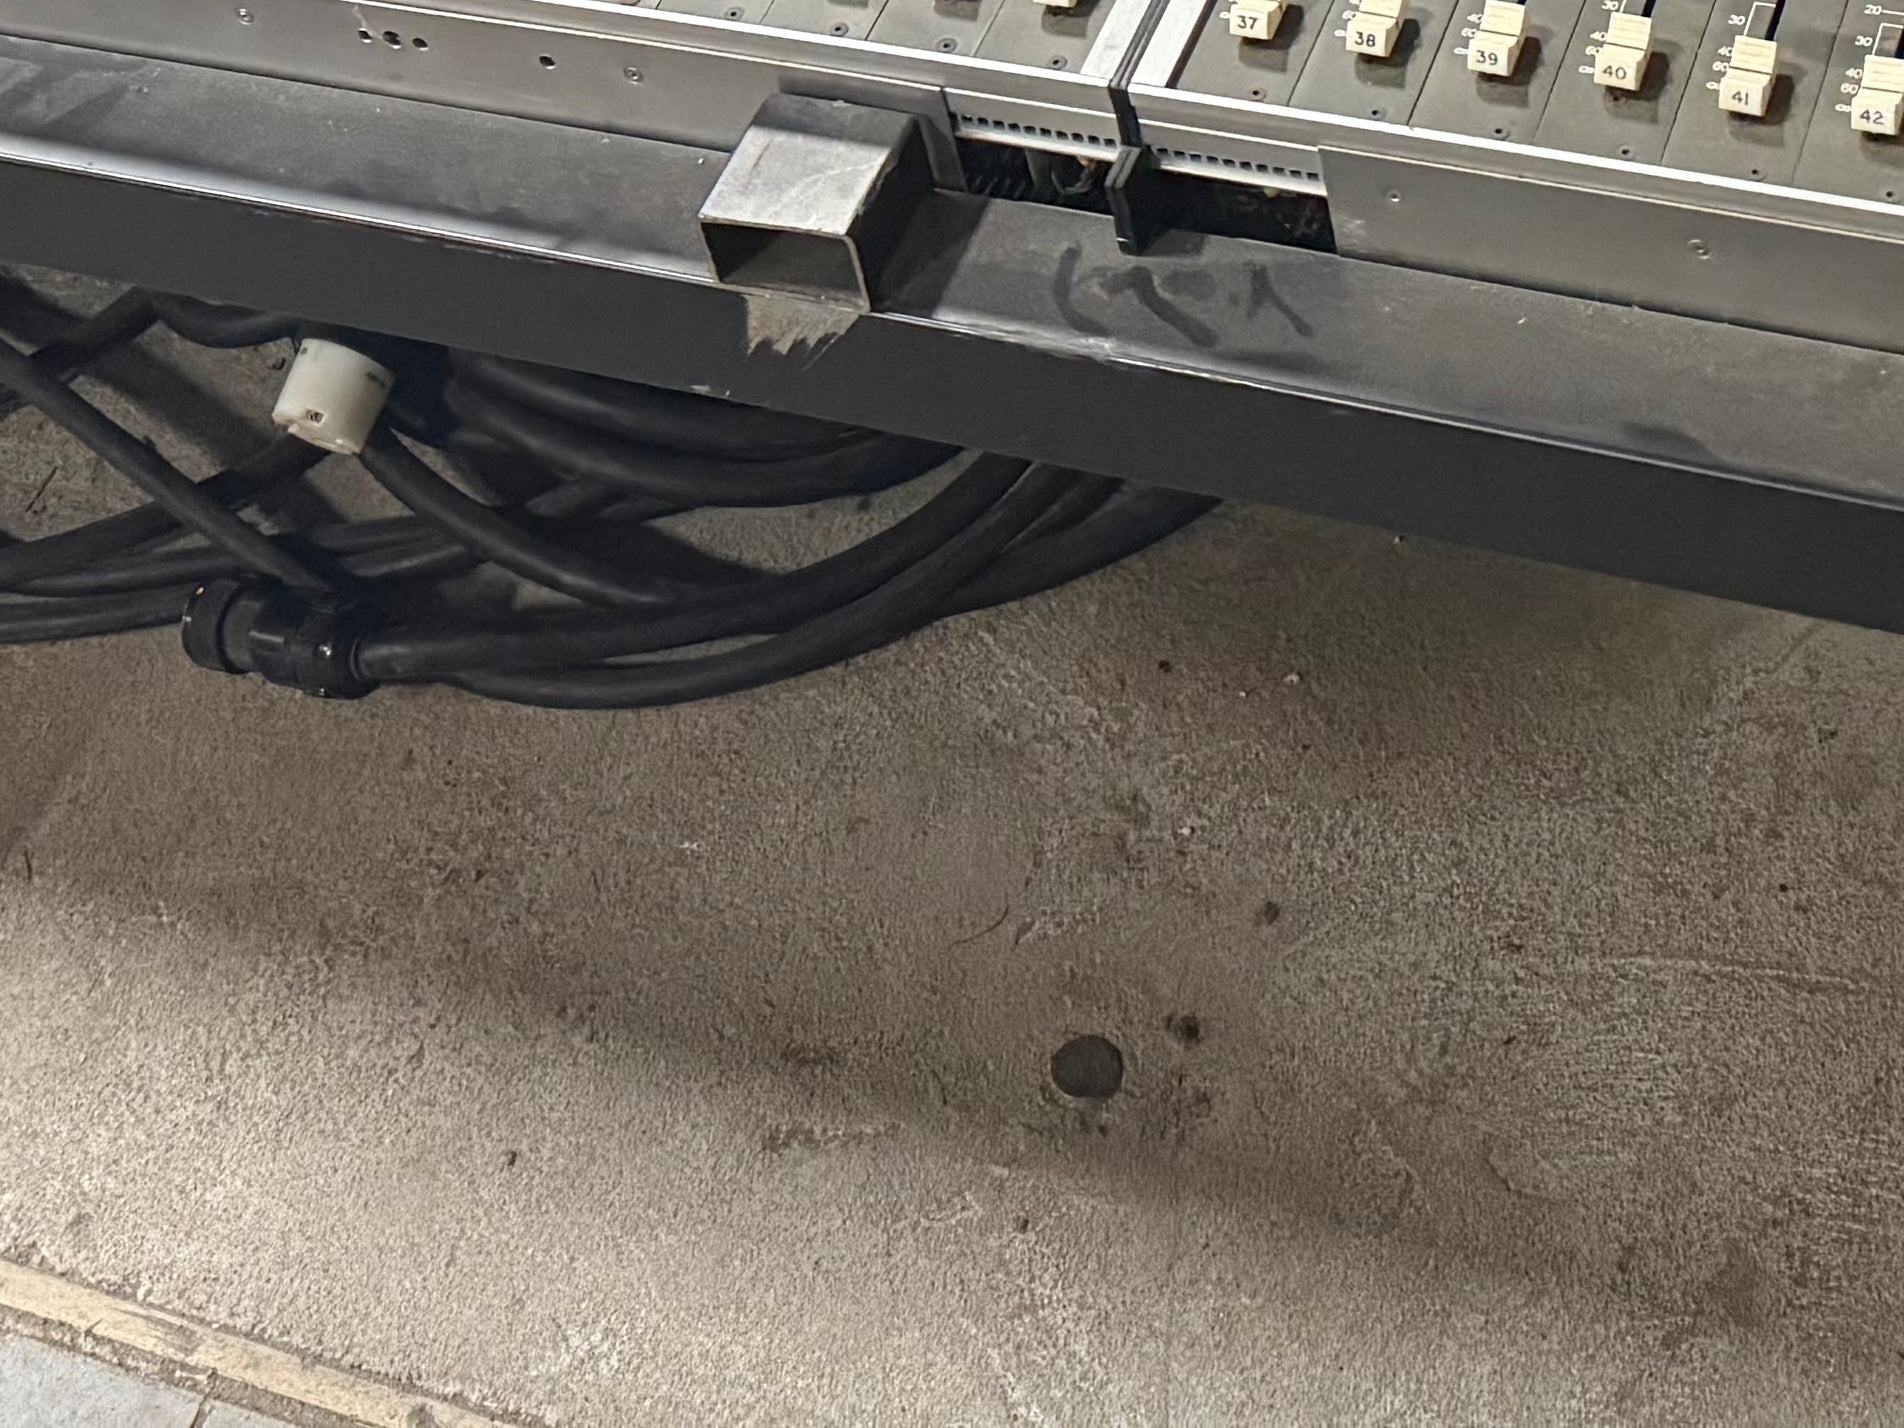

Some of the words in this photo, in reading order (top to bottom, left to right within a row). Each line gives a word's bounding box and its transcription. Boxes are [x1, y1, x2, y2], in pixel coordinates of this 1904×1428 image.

[1864, 5, 1882, 15] 20
[1237, 15, 1259, 31] 37
[1356, 31, 1377, 46] 38
[1477, 50, 1498, 66] 39
[1603, 64, 1628, 81] 40
[1732, 88, 1751, 105] 41
[1860, 109, 1884, 126] 42
